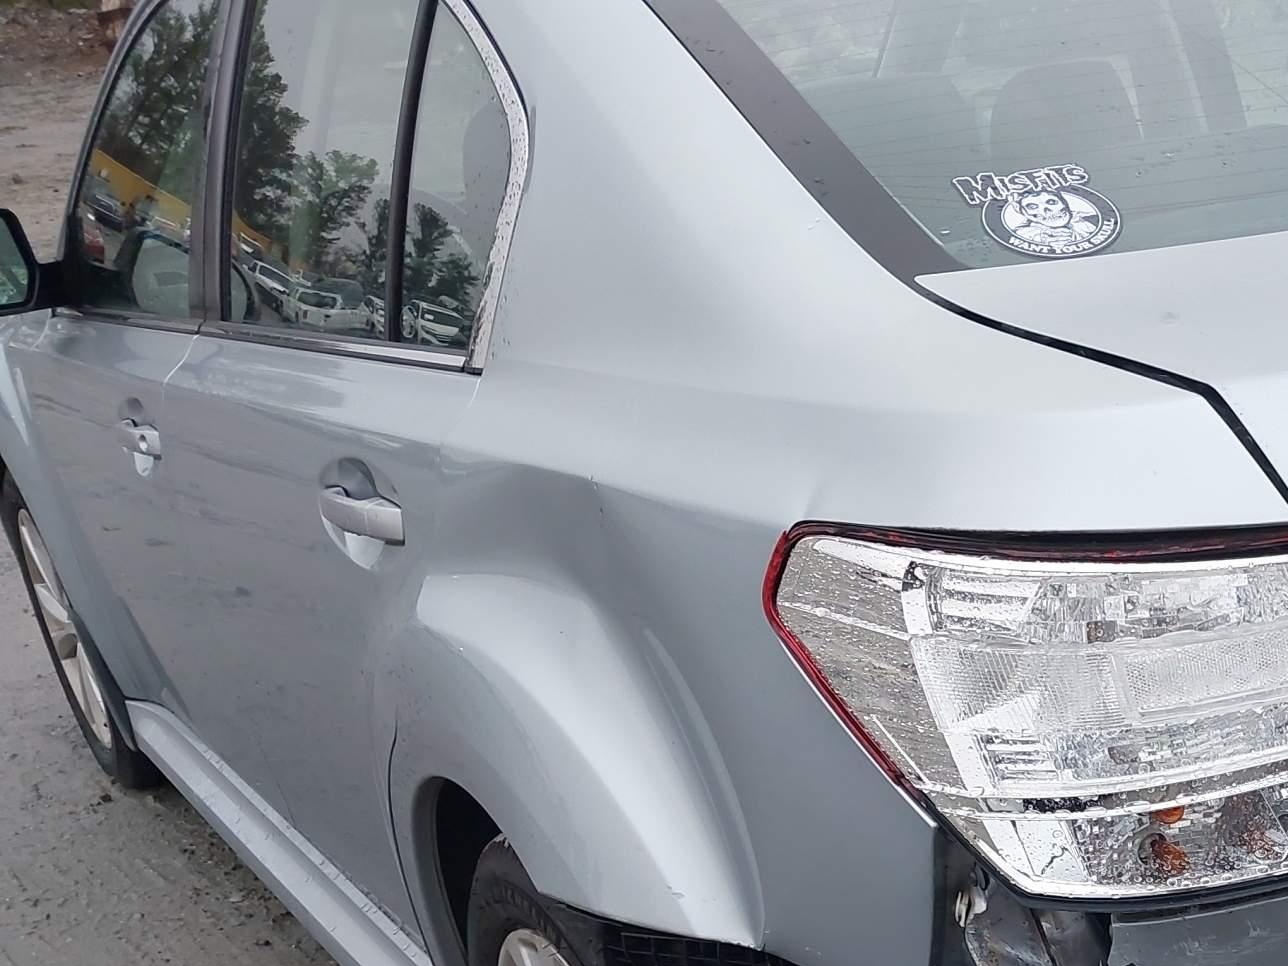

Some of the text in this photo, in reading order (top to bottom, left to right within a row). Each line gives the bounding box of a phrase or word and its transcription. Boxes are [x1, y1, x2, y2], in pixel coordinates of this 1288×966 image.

[1009, 218, 1115, 254] WANT YOUR SKULL
